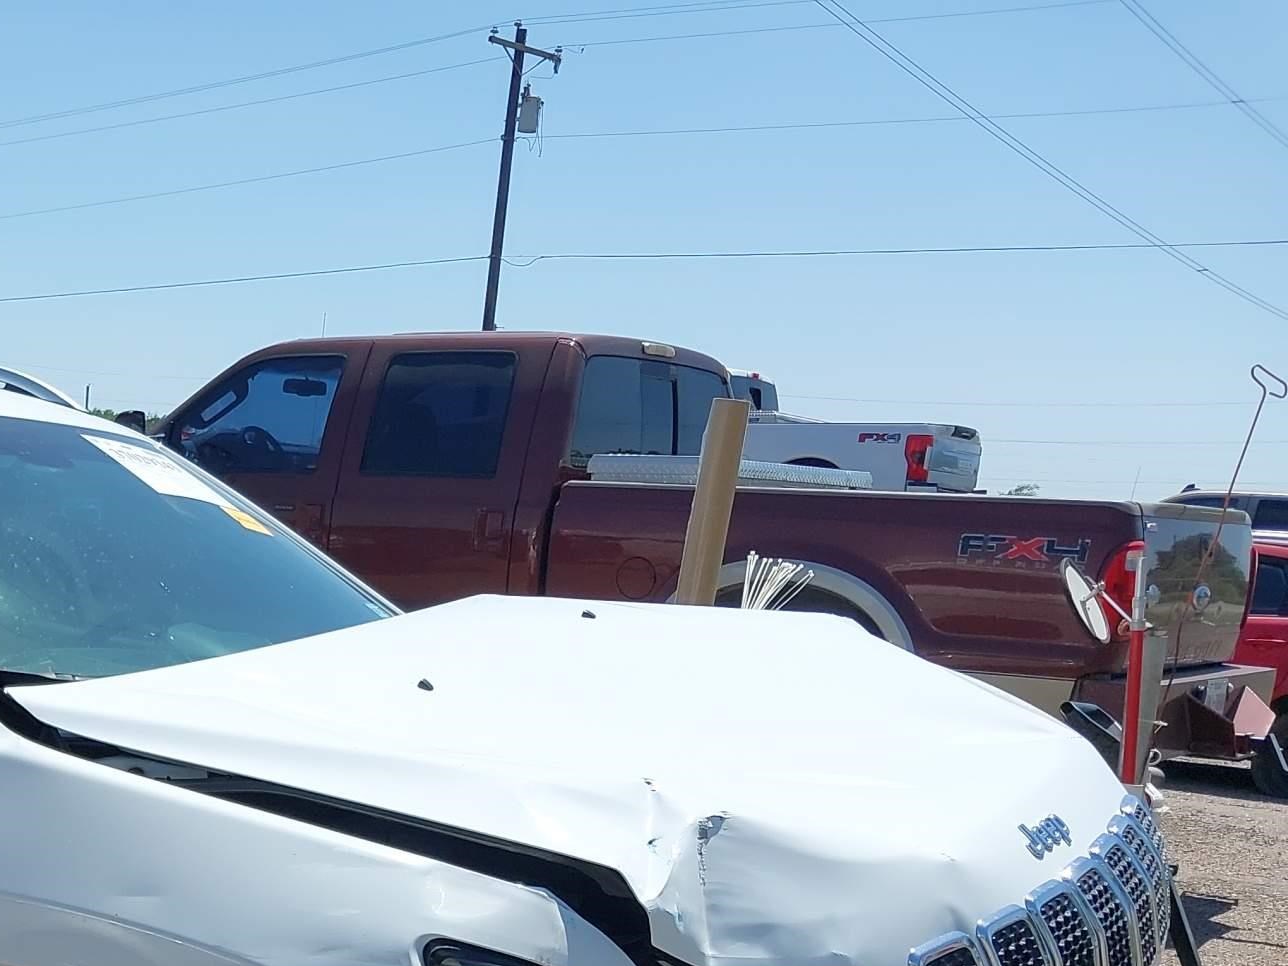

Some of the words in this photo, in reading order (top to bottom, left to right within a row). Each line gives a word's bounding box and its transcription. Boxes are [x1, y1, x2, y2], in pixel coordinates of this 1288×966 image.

[857, 432, 901, 444] FX4
[958, 533, 1091, 564] FX4
[1017, 813, 1073, 861] Jeep
